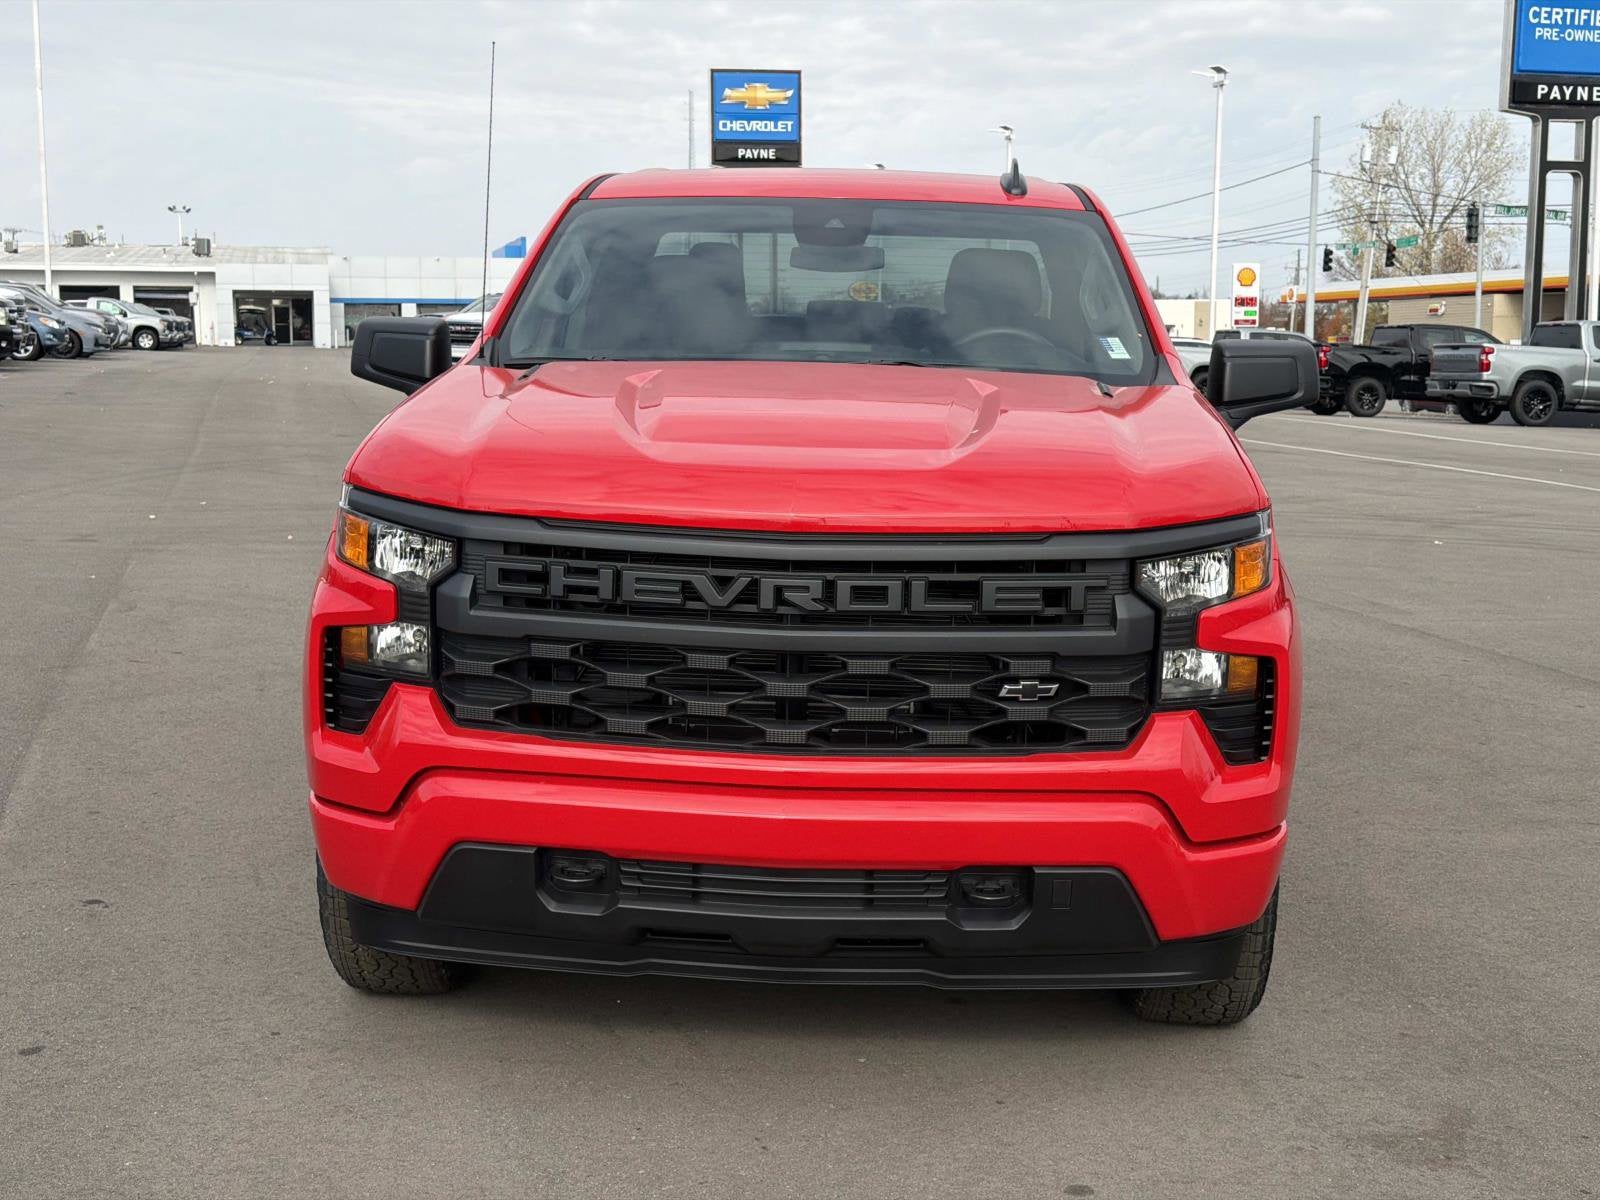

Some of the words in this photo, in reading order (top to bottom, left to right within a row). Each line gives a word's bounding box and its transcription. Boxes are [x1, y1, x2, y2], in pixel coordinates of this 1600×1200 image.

[1537, 84, 1600, 101] PAYNE
[718, 120, 794, 132] CHEVROLET
[737, 148, 776, 159] PAYNE
[484, 560, 1109, 613] CHEVROLET
